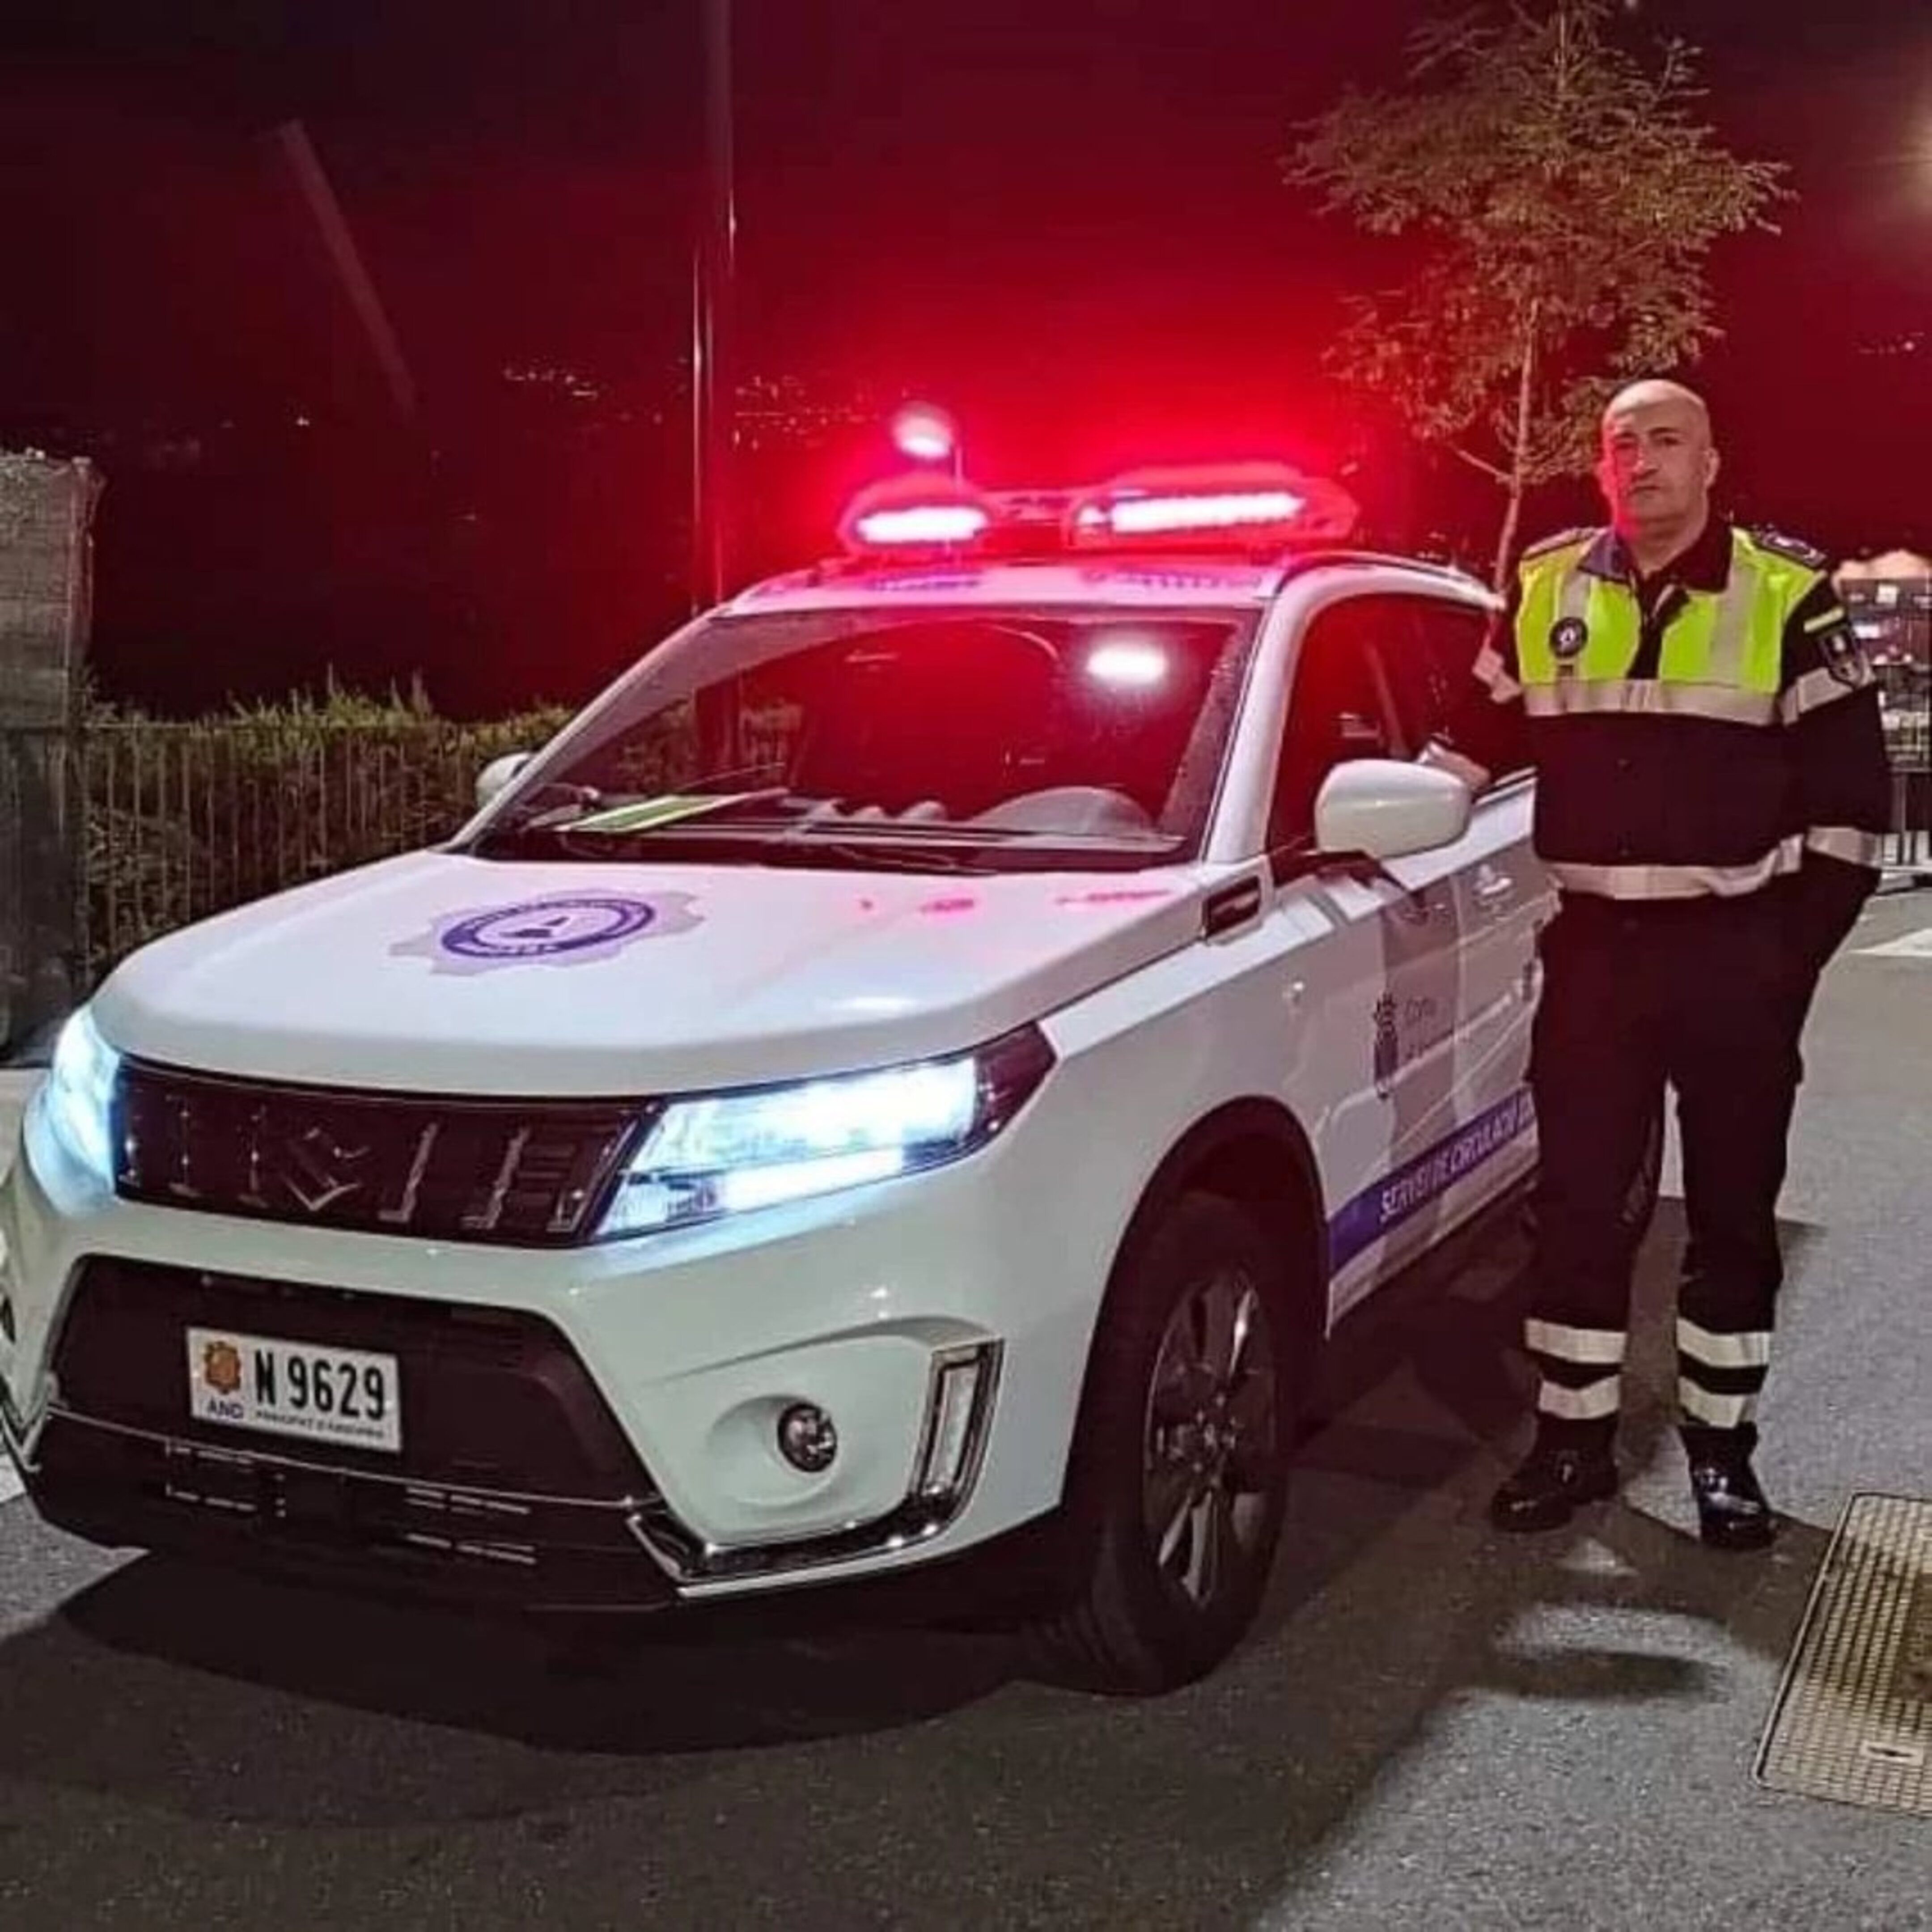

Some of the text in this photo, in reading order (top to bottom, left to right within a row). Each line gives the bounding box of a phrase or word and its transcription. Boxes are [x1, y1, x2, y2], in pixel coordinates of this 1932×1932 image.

[255, 1349, 385, 1420] N 9629
[207, 1398, 244, 1419] AND
